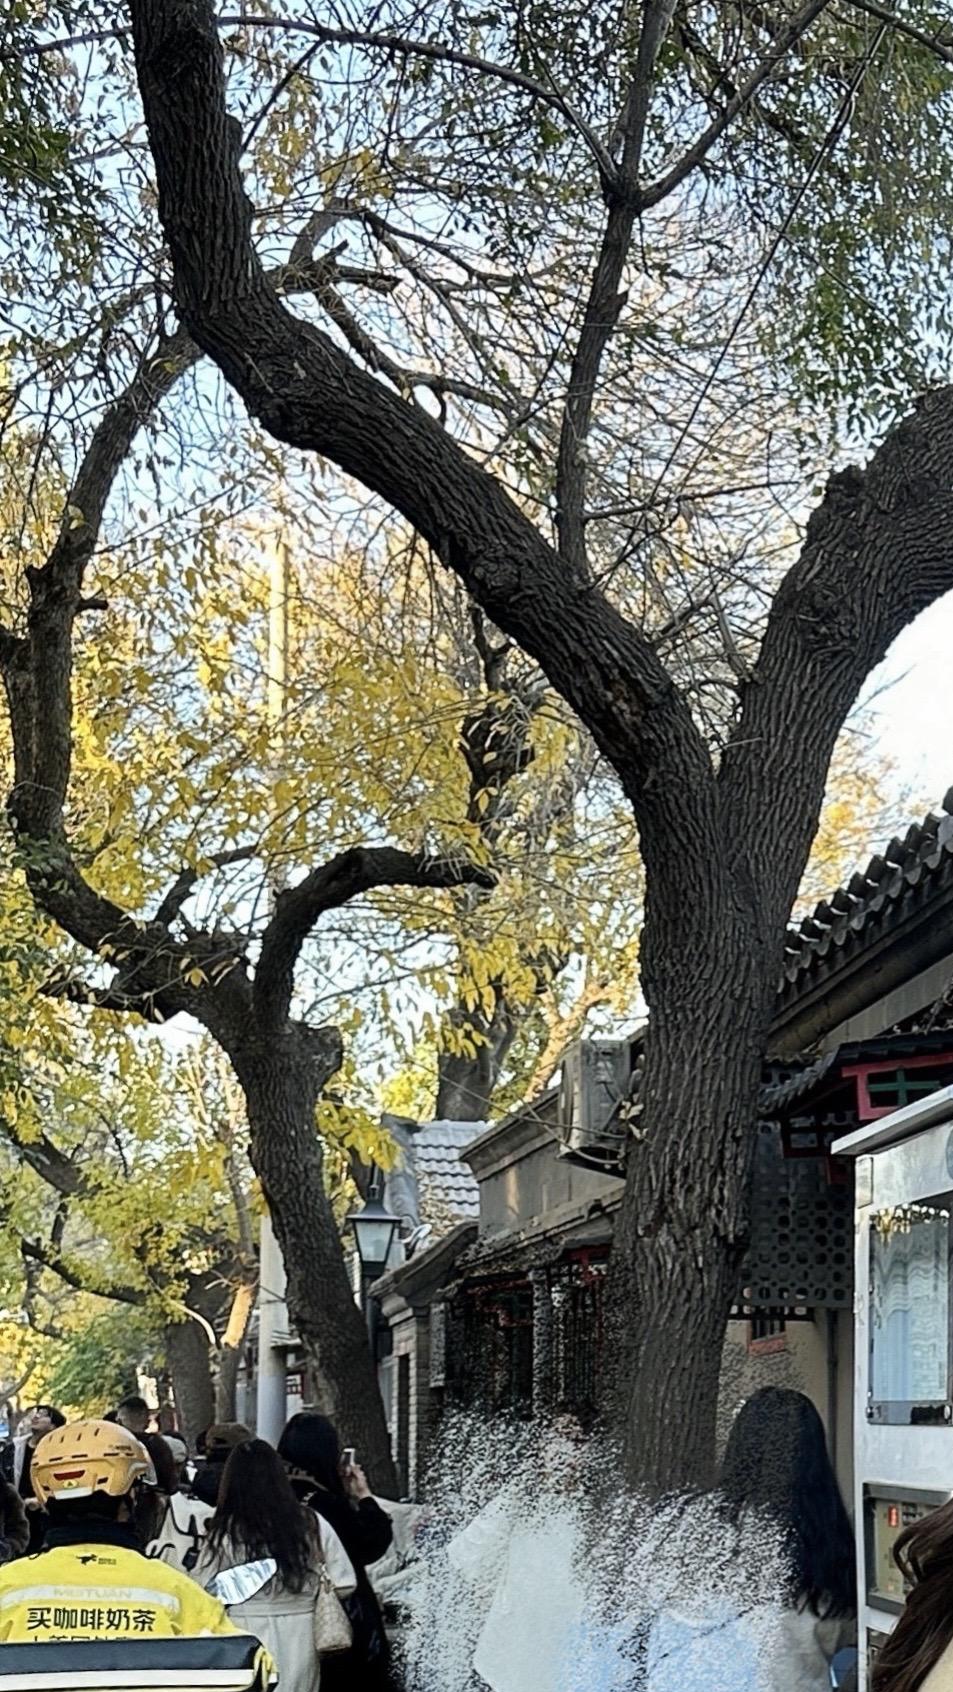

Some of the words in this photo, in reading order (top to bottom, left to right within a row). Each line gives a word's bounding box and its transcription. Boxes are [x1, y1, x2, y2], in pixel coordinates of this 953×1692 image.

[53, 1587, 132, 1600] MEITUAN
[27, 1607, 156, 1632] 买咖啡奶茶
